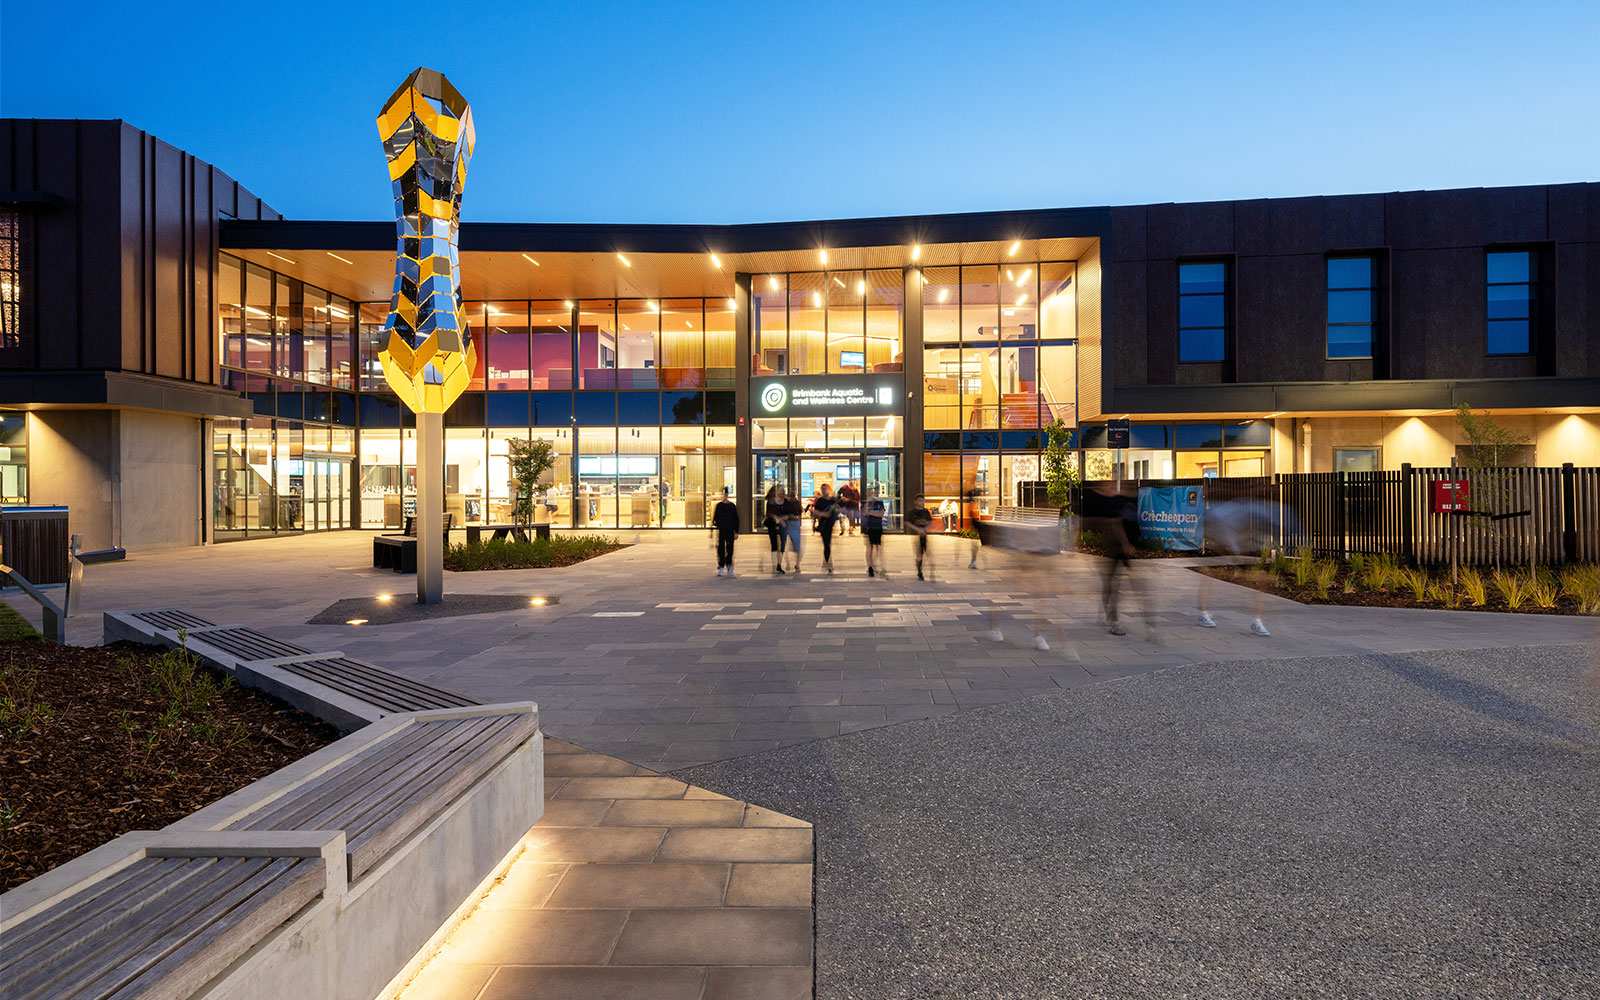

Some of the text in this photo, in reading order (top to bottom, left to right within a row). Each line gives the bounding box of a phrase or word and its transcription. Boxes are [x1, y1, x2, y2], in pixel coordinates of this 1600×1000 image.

[792, 388, 864, 400] Brimbank Aquatic
[792, 395, 874, 405] and Wellness Centre
